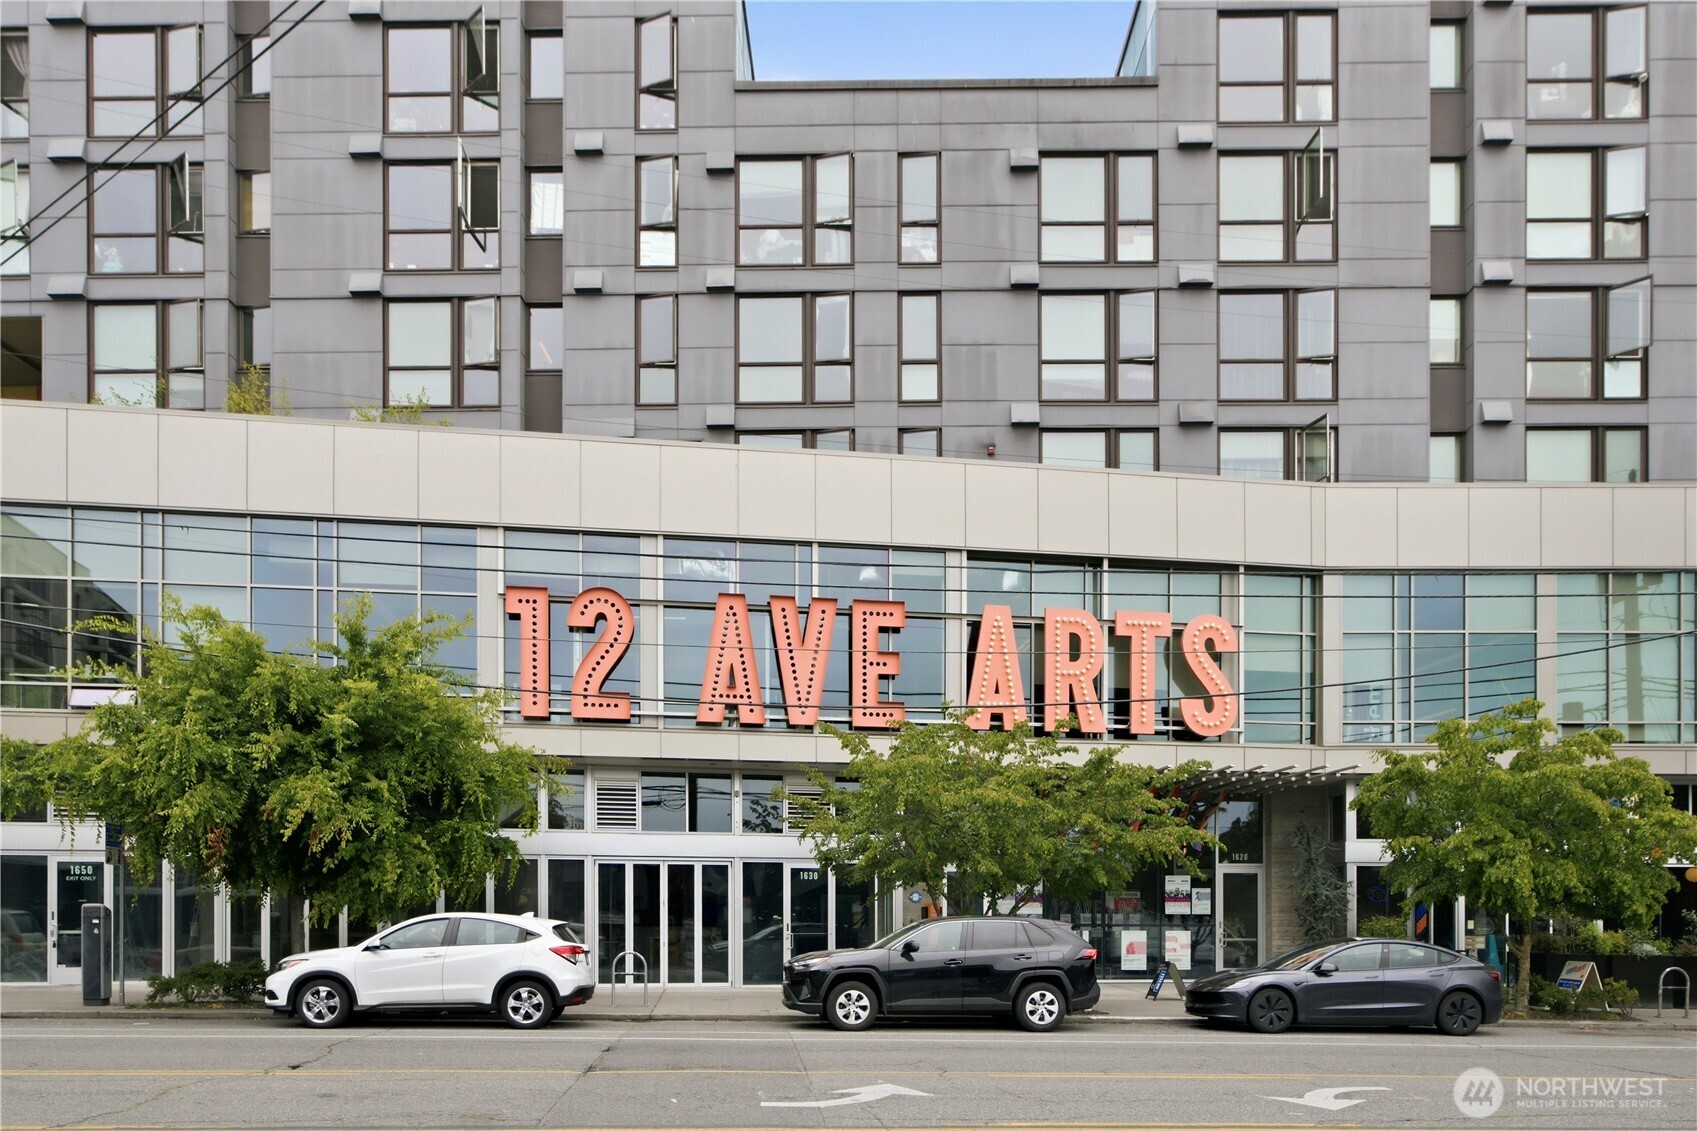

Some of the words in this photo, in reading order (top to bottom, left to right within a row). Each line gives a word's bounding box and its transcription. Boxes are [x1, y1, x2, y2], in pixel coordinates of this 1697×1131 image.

[504, 585, 635, 719] 12
[696, 593, 905, 728] AVE
[966, 604, 1239, 738] ARTS
[70, 865, 93, 875] 1650
[800, 871, 818, 880] 1630
